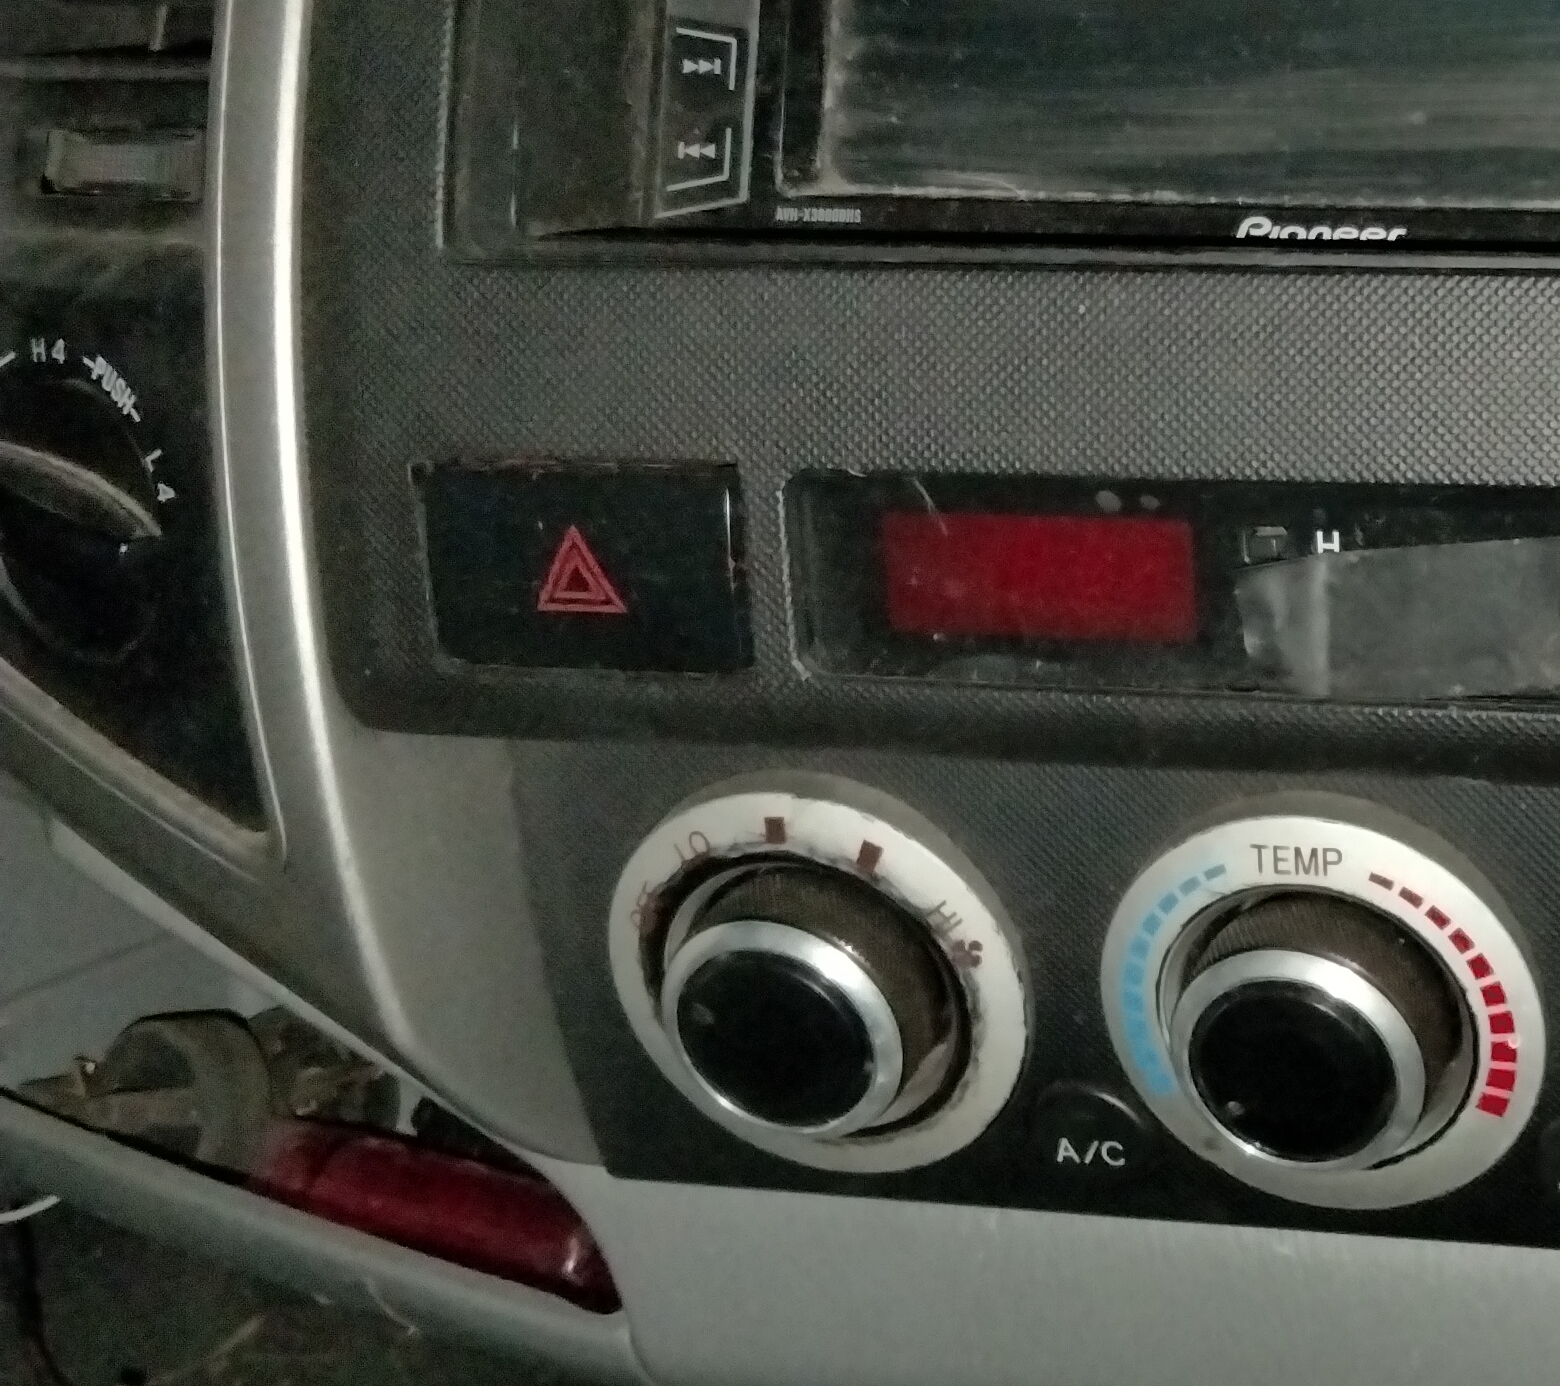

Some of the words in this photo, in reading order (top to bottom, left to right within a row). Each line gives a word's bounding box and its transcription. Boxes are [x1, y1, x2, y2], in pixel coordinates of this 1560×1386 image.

[1235, 216, 1408, 242] Pioneer
[1316, 530, 1340, 554] H
[1249, 843, 1343, 877] TEMP
[1056, 1137, 1126, 1166] A/C
